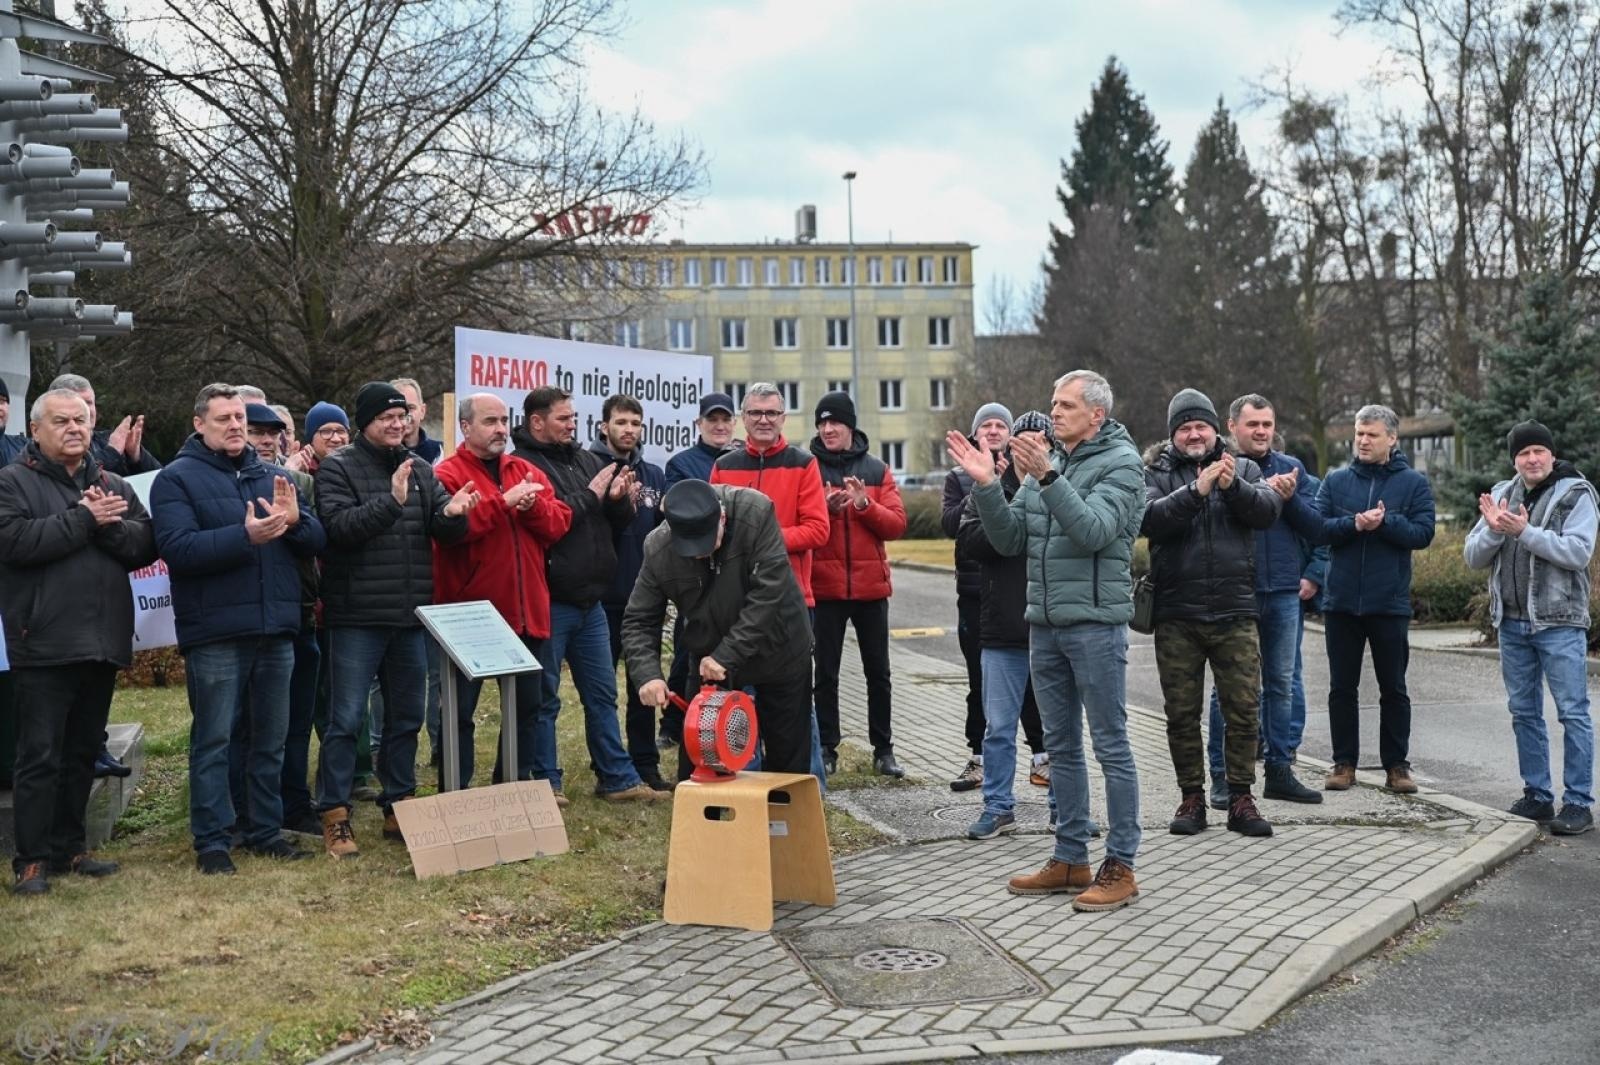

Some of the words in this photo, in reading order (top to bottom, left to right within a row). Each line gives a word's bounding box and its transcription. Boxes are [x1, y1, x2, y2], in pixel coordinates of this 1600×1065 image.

[470, 354, 548, 391] RAFAKO
[555, 364, 574, 395] to
[582, 367, 610, 397] nie
[618, 370, 703, 410] ideologia!
